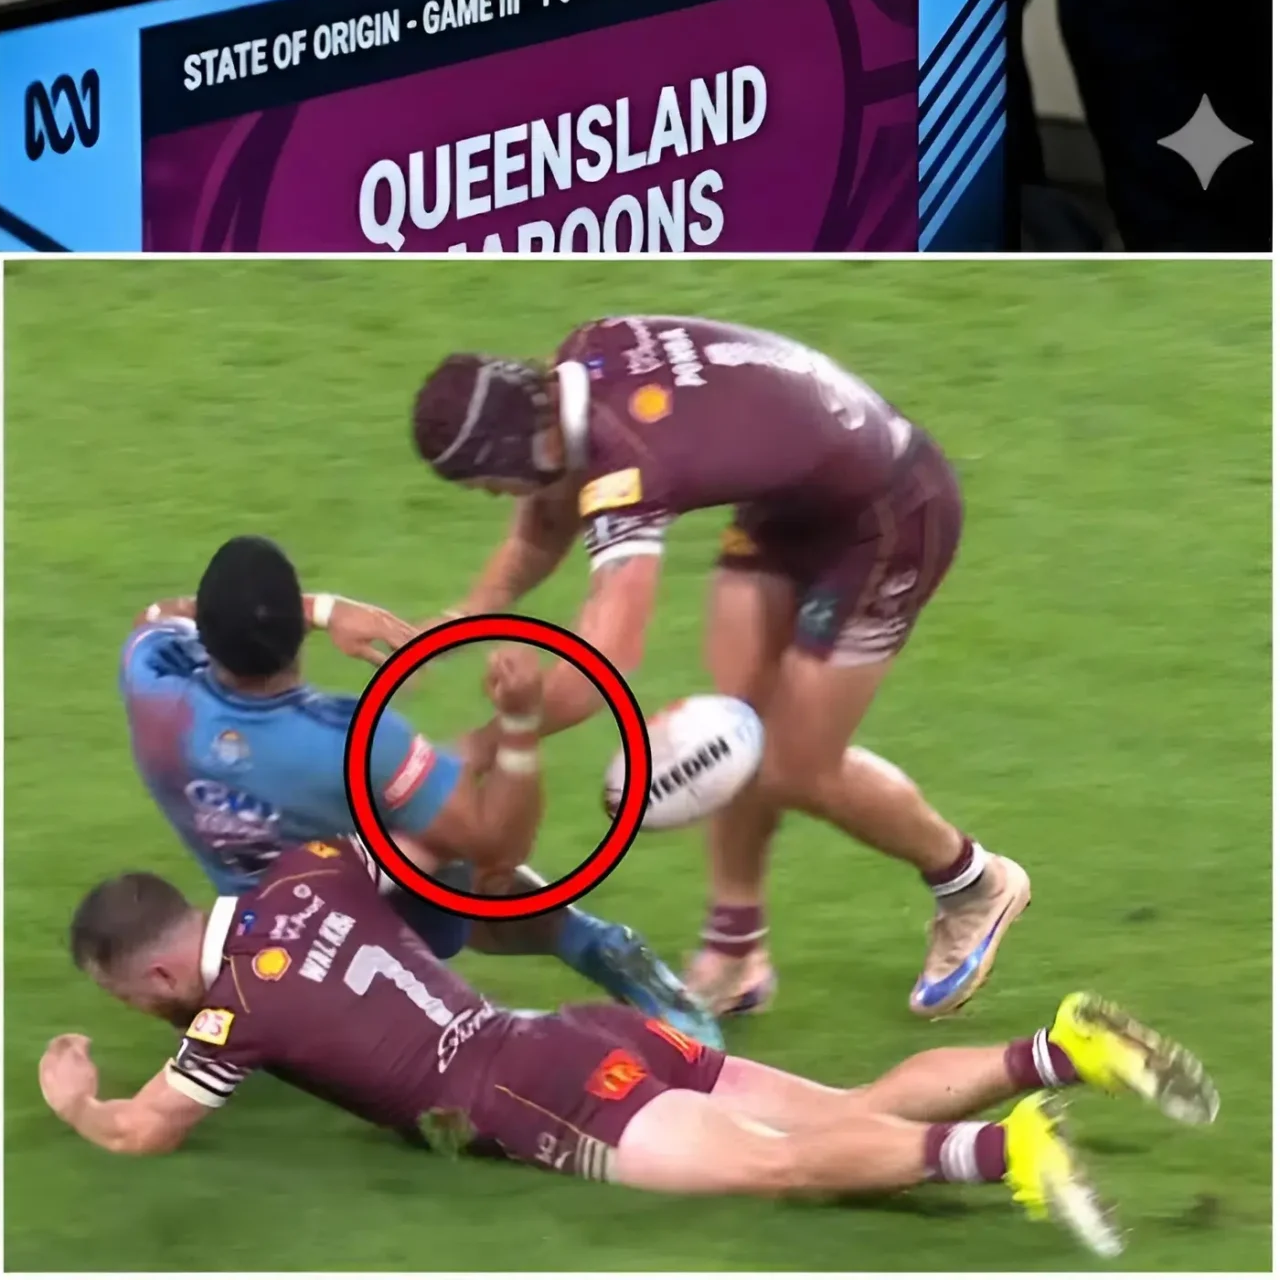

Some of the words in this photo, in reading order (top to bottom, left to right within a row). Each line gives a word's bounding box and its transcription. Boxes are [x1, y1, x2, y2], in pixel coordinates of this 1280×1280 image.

[183, 39, 268, 91] STATE
[273, 29, 307, 69] OF
[313, 9, 400, 60] ORIGIN
[359, 65, 767, 252] QUEENSLAND
[447, 168, 724, 252] OONS
[649, 734, 732, 810] TEEDEN
[343, 943, 454, 1027] 7
